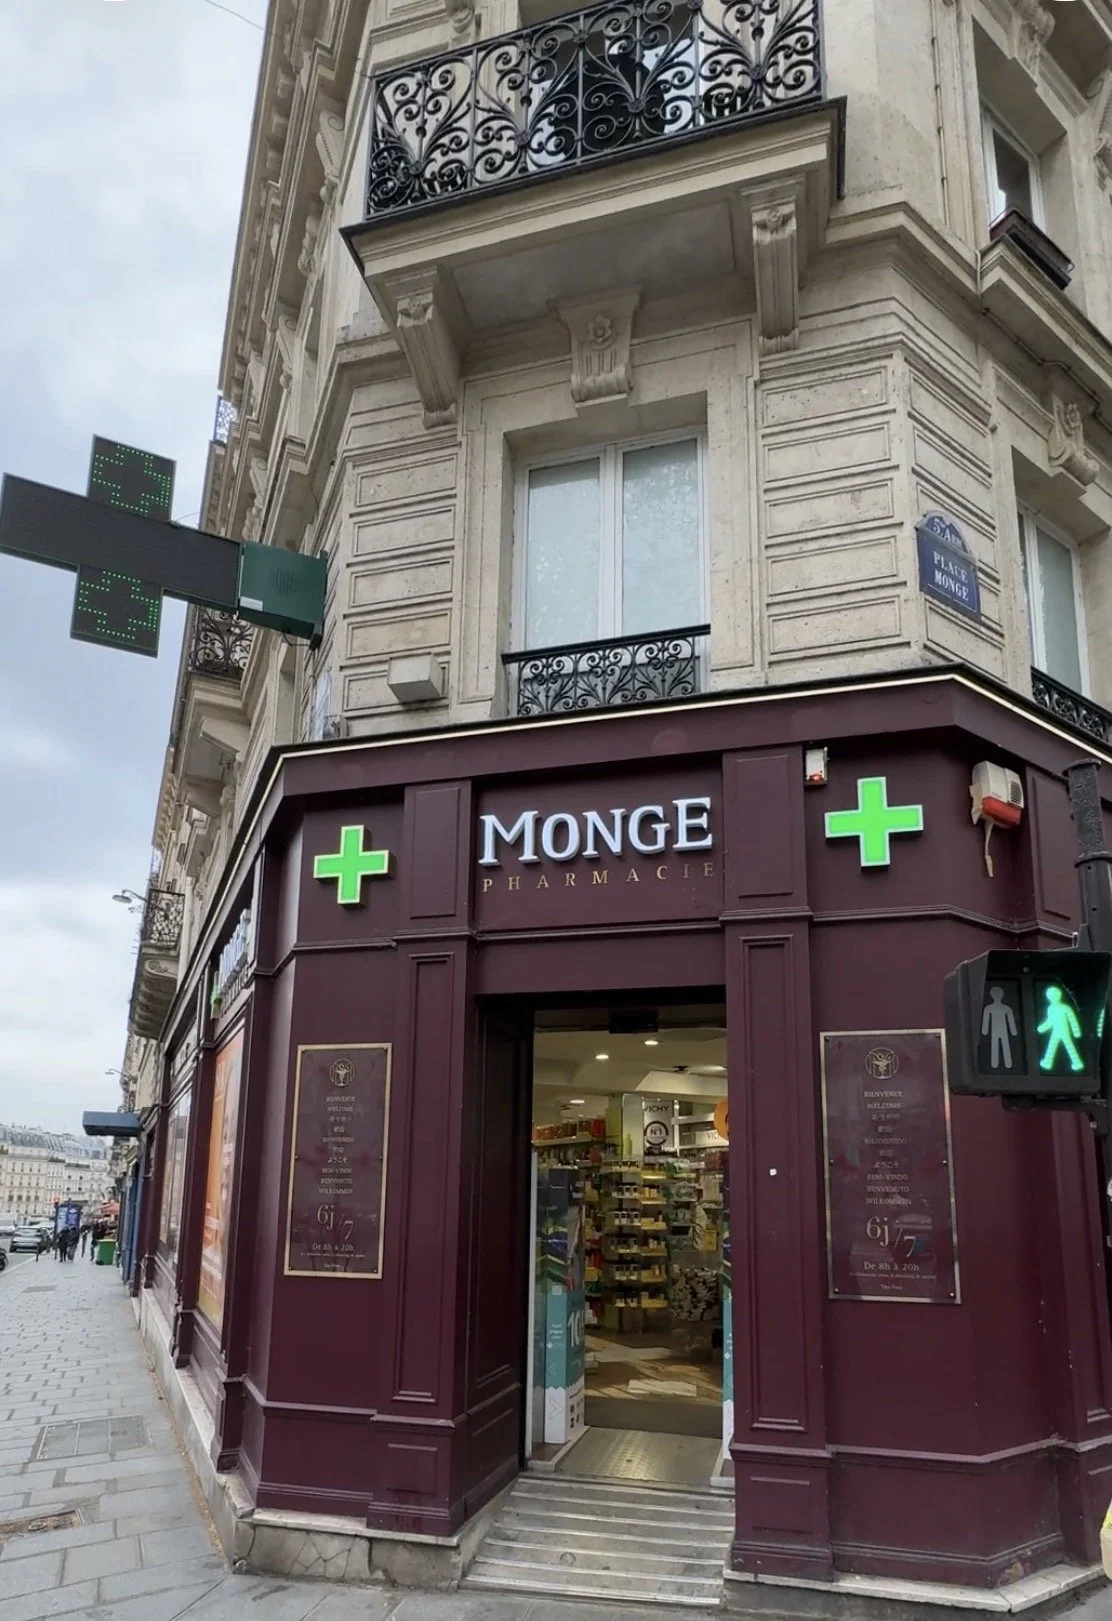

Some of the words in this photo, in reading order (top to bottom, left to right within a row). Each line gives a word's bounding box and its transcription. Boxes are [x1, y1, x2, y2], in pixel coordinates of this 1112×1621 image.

[933, 551, 968, 583] PLACE
[934, 569, 969, 601] MONGE
[478, 797, 713, 867] MONGE
[482, 862, 714, 893] PHARMACIE
[863, 1261, 876, 1271] De
[878, 1263, 890, 1271] 8h
[902, 1263, 920, 1272] 20h
